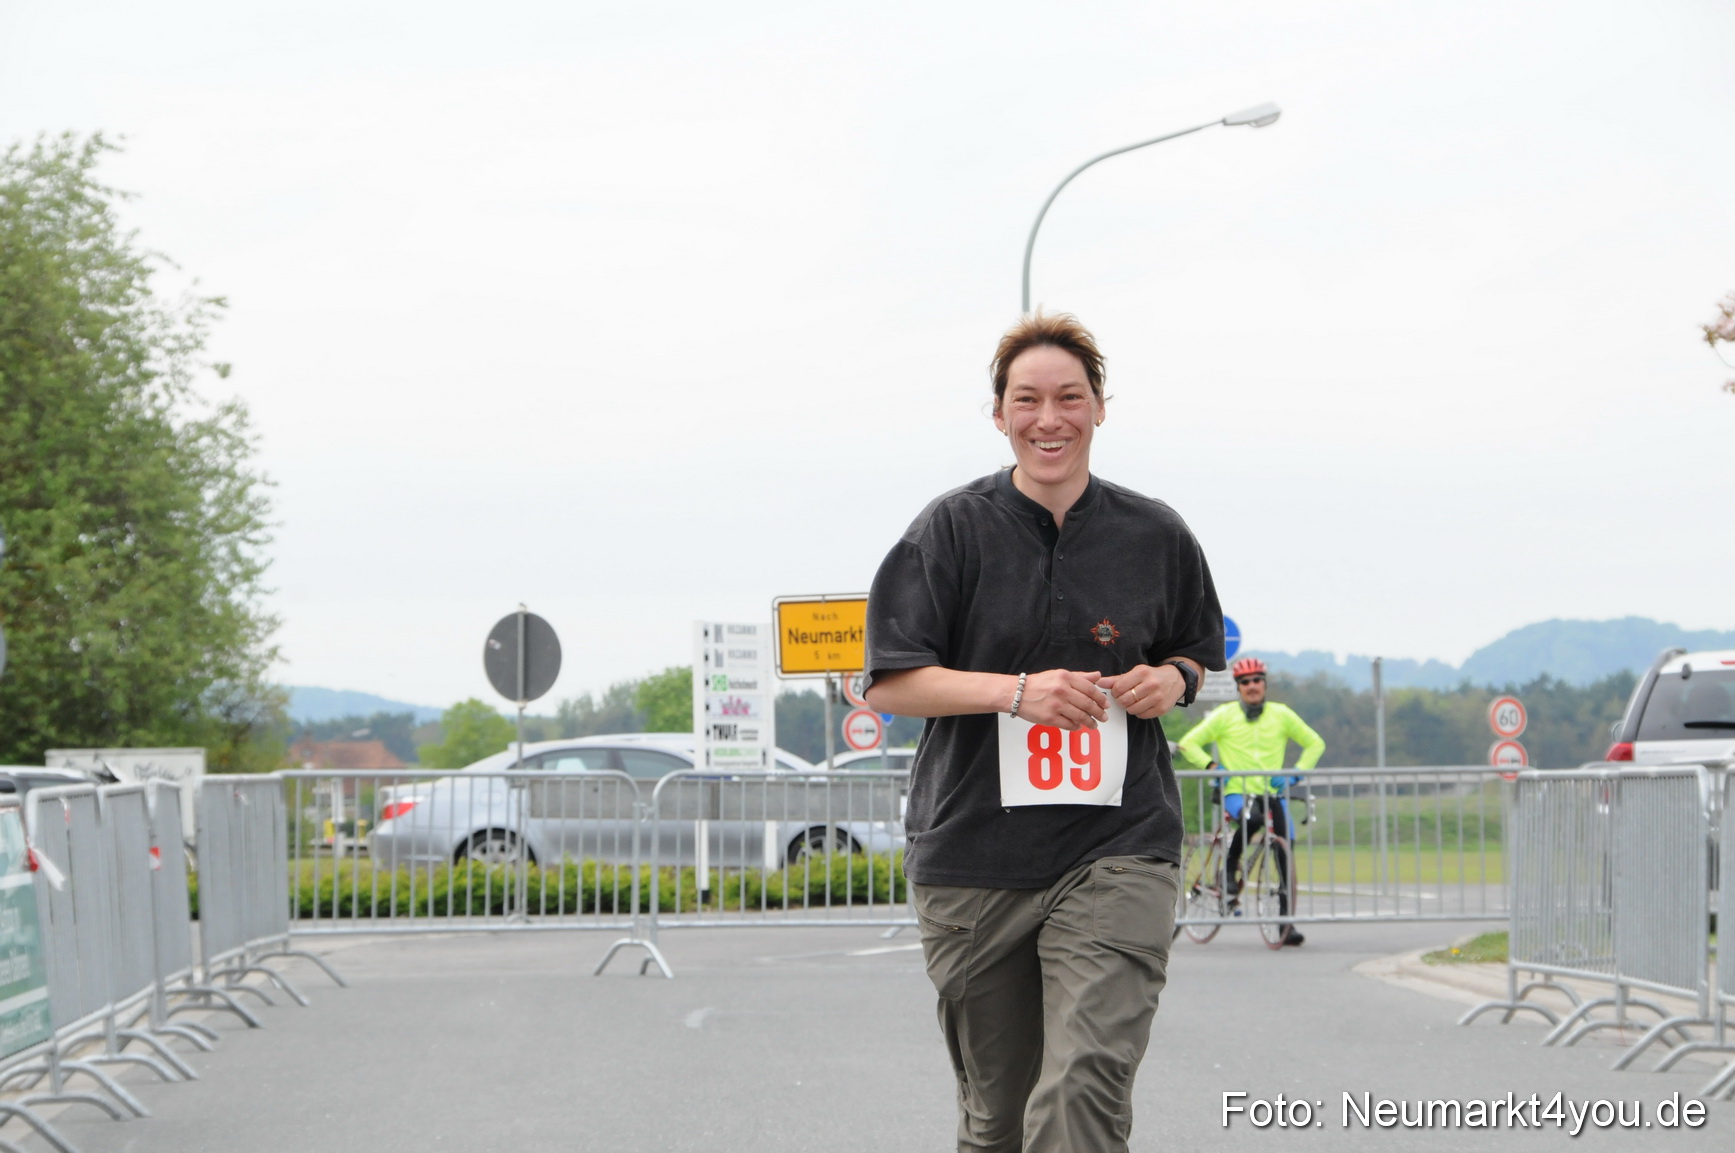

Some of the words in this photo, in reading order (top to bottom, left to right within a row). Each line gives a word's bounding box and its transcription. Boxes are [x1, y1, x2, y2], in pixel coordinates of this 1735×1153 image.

[812, 612, 839, 621] Nach
[788, 626, 864, 645] Neumarkt
[814, 651, 820, 660] 5
[827, 651, 841, 660] km
[1499, 709, 1519, 727] 60
[1027, 723, 1102, 791] 89
